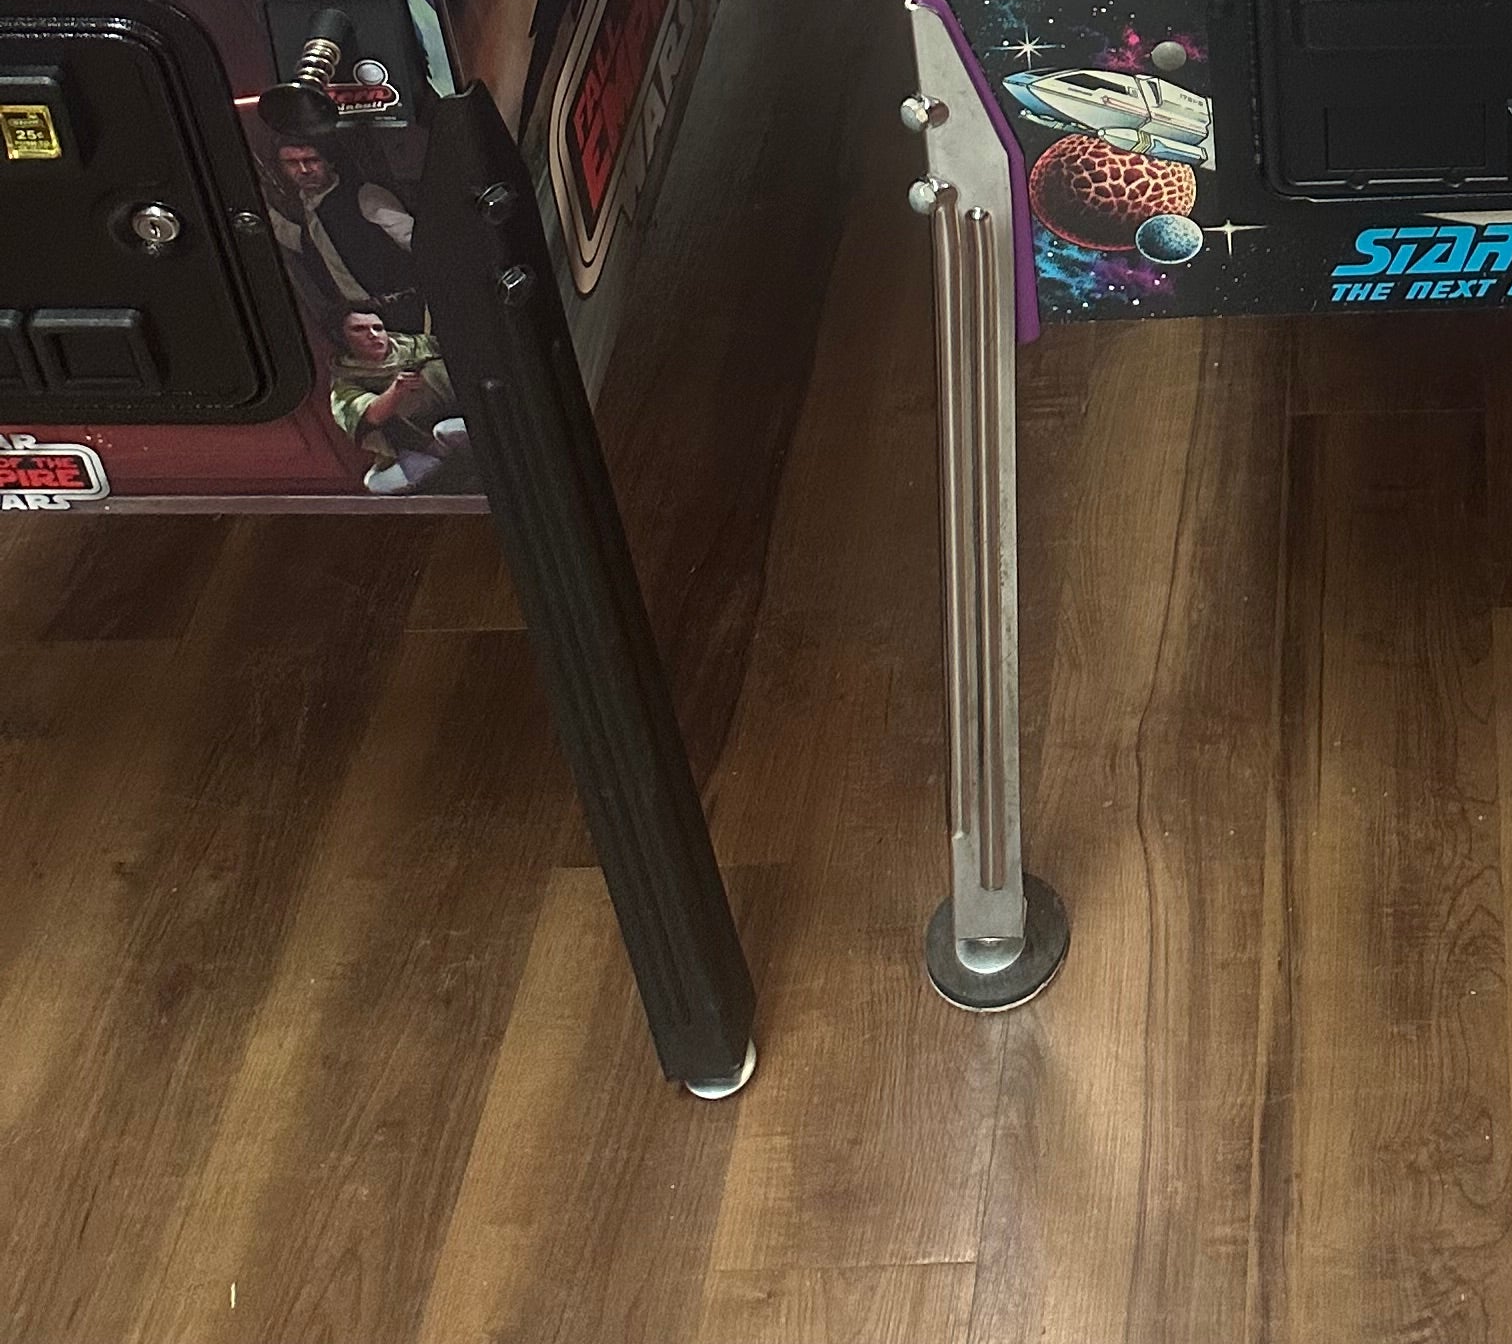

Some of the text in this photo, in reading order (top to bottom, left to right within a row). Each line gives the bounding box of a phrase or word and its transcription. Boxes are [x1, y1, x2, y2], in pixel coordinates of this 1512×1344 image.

[1331, 278, 1395, 302] THE
[1405, 277, 1497, 300] NEXT
[0, 434, 37, 450] AR
[33, 457, 78, 468] THE
[0, 468, 85, 487] PIRE
[1, 494, 72, 510] ARS
